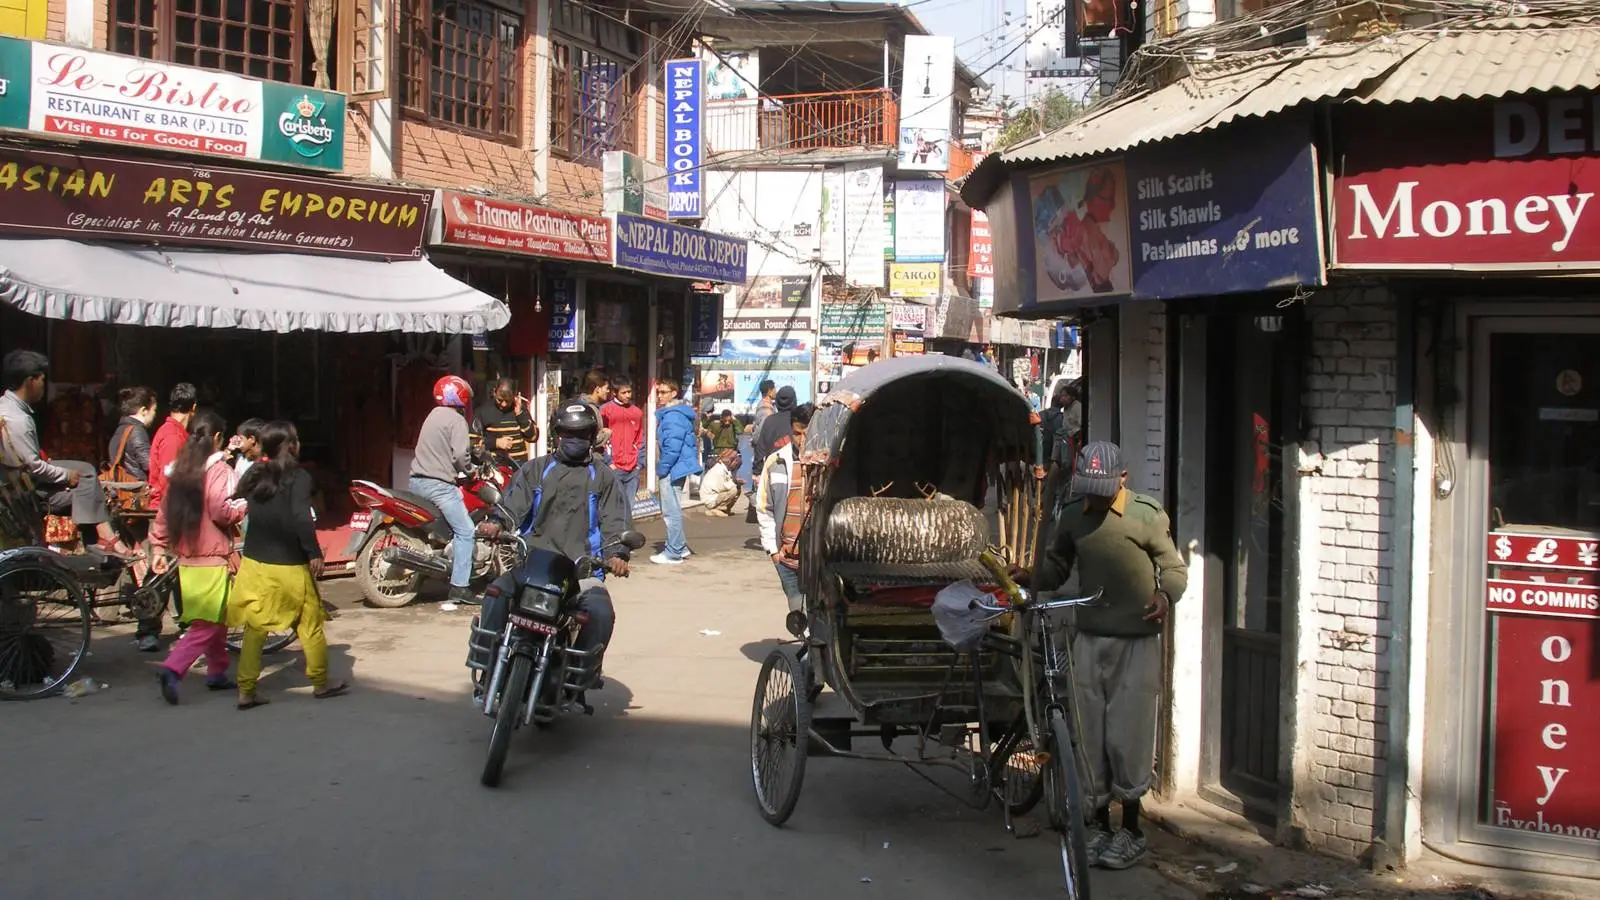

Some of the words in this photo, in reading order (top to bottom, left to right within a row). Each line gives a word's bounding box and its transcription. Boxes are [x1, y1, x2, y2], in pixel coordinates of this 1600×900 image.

[673, 67, 694, 124] NEPAL
[47, 96, 140, 122] RESTAURANT
[144, 112, 156, 125] &
[160, 113, 188, 129] BAR
[193, 116, 215, 134] (P.)
[219, 122, 248, 137] LTD.
[279, 112, 335, 143] Carlsberg
[53, 118, 93, 134] Visit
[99, 126, 117, 137] us
[122, 128, 148, 142] for
[153, 133, 199, 149] Good
[204, 140, 245, 154] Food
[192, 169, 211, 179] 786
[673, 129, 694, 185] BOOK
[0, 161, 115, 198] ASIAN
[143, 177, 234, 209] ARTS
[259, 188, 418, 228] EMPORIUM
[668, 191, 699, 212] DEPOT
[1137, 178, 1164, 200] Silk
[1168, 167, 1213, 195] Scarfs
[67, 212, 142, 230] (Specialist
[167, 220, 196, 237] High
[200, 223, 247, 238] Fashion
[250, 227, 293, 242] Leather
[296, 230, 354, 248] Garments)
[167, 206, 183, 218] A
[184, 208, 225, 222] Land
[228, 210, 244, 226] Of
[247, 213, 274, 226] Art
[474, 199, 522, 232] Thamel
[581, 219, 608, 243] Point
[1140, 209, 1167, 231] Silk
[1170, 200, 1221, 227] Shawls
[1348, 181, 1595, 252] Money
[628, 221, 670, 254] NEPAL
[672, 230, 708, 261] BOOK
[709, 238, 746, 267] DEPOT
[1142, 235, 1218, 262] Pashminas
[1255, 226, 1299, 249] more
[893, 271, 936, 280] CARGO
[723, 320, 761, 329] Education
[764, 320, 807, 329] Foundtion
[1489, 587, 1516, 603] NO
[1521, 590, 1599, 609] COMMIS
